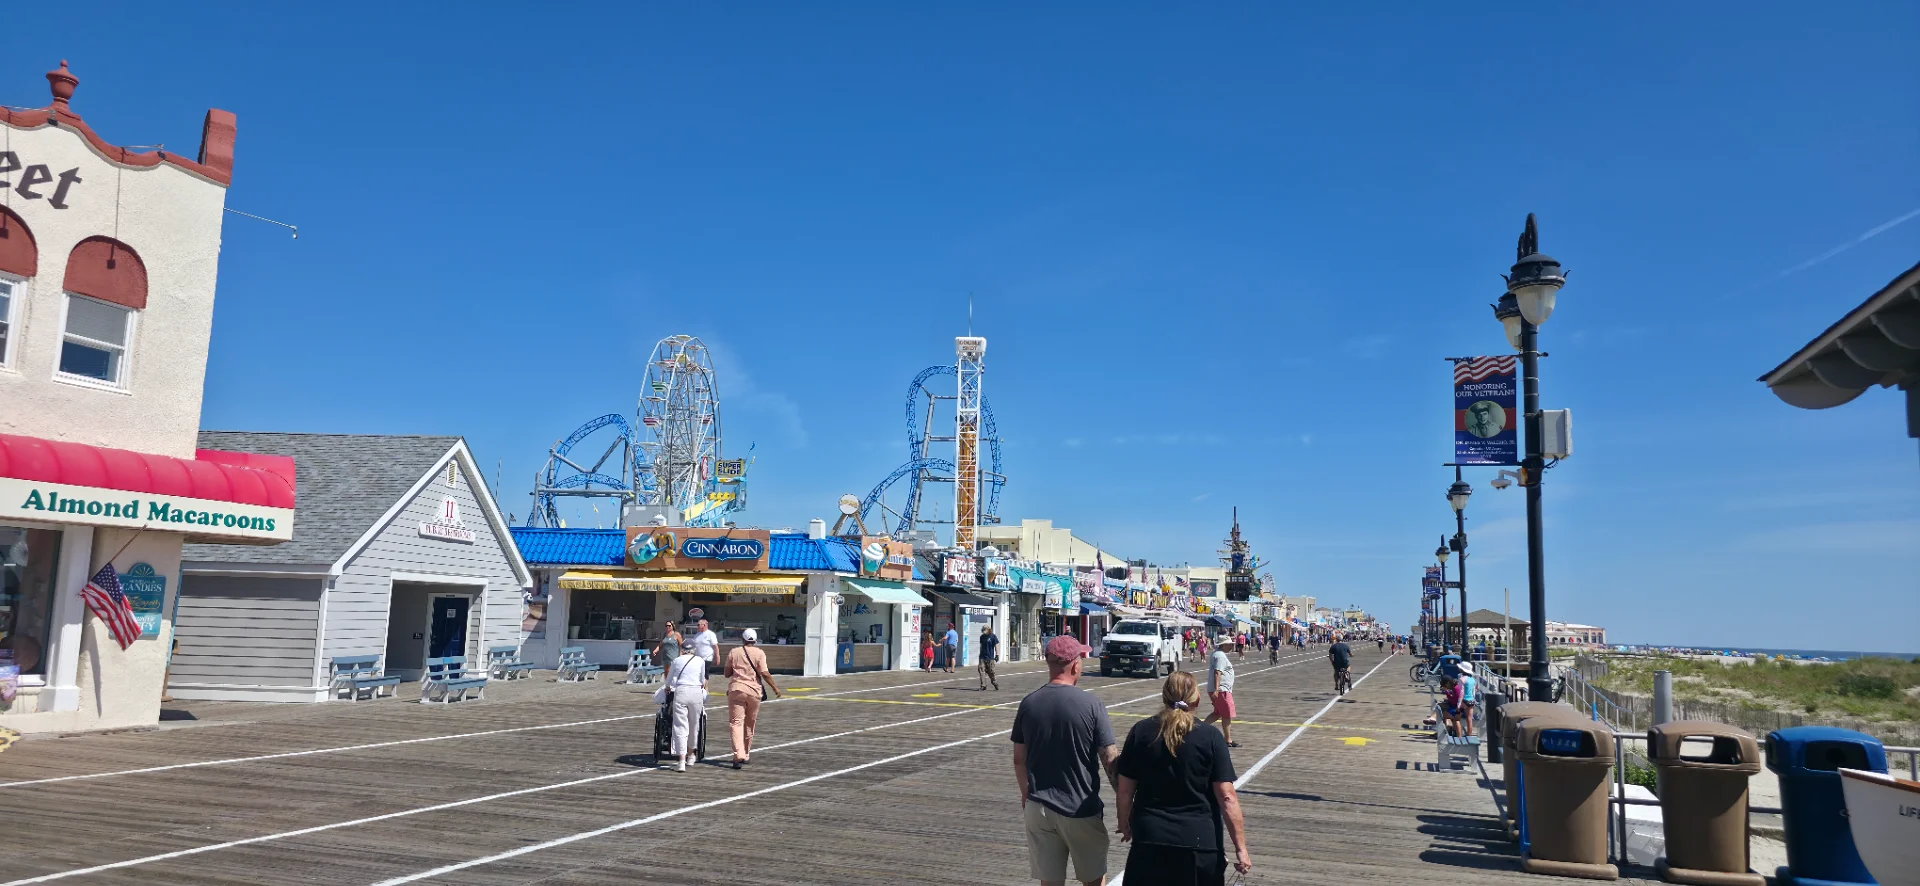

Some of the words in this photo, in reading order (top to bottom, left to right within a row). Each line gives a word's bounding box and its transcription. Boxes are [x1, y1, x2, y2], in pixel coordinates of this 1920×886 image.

[1475, 389, 1515, 397] VETERANS
[21, 489, 139, 520] Almond
[146, 501, 276, 532] Macaroons
[445, 500, 454, 518] 11
[687, 541, 758, 555] CINNABON
[122, 582, 162, 593] CANDIES
